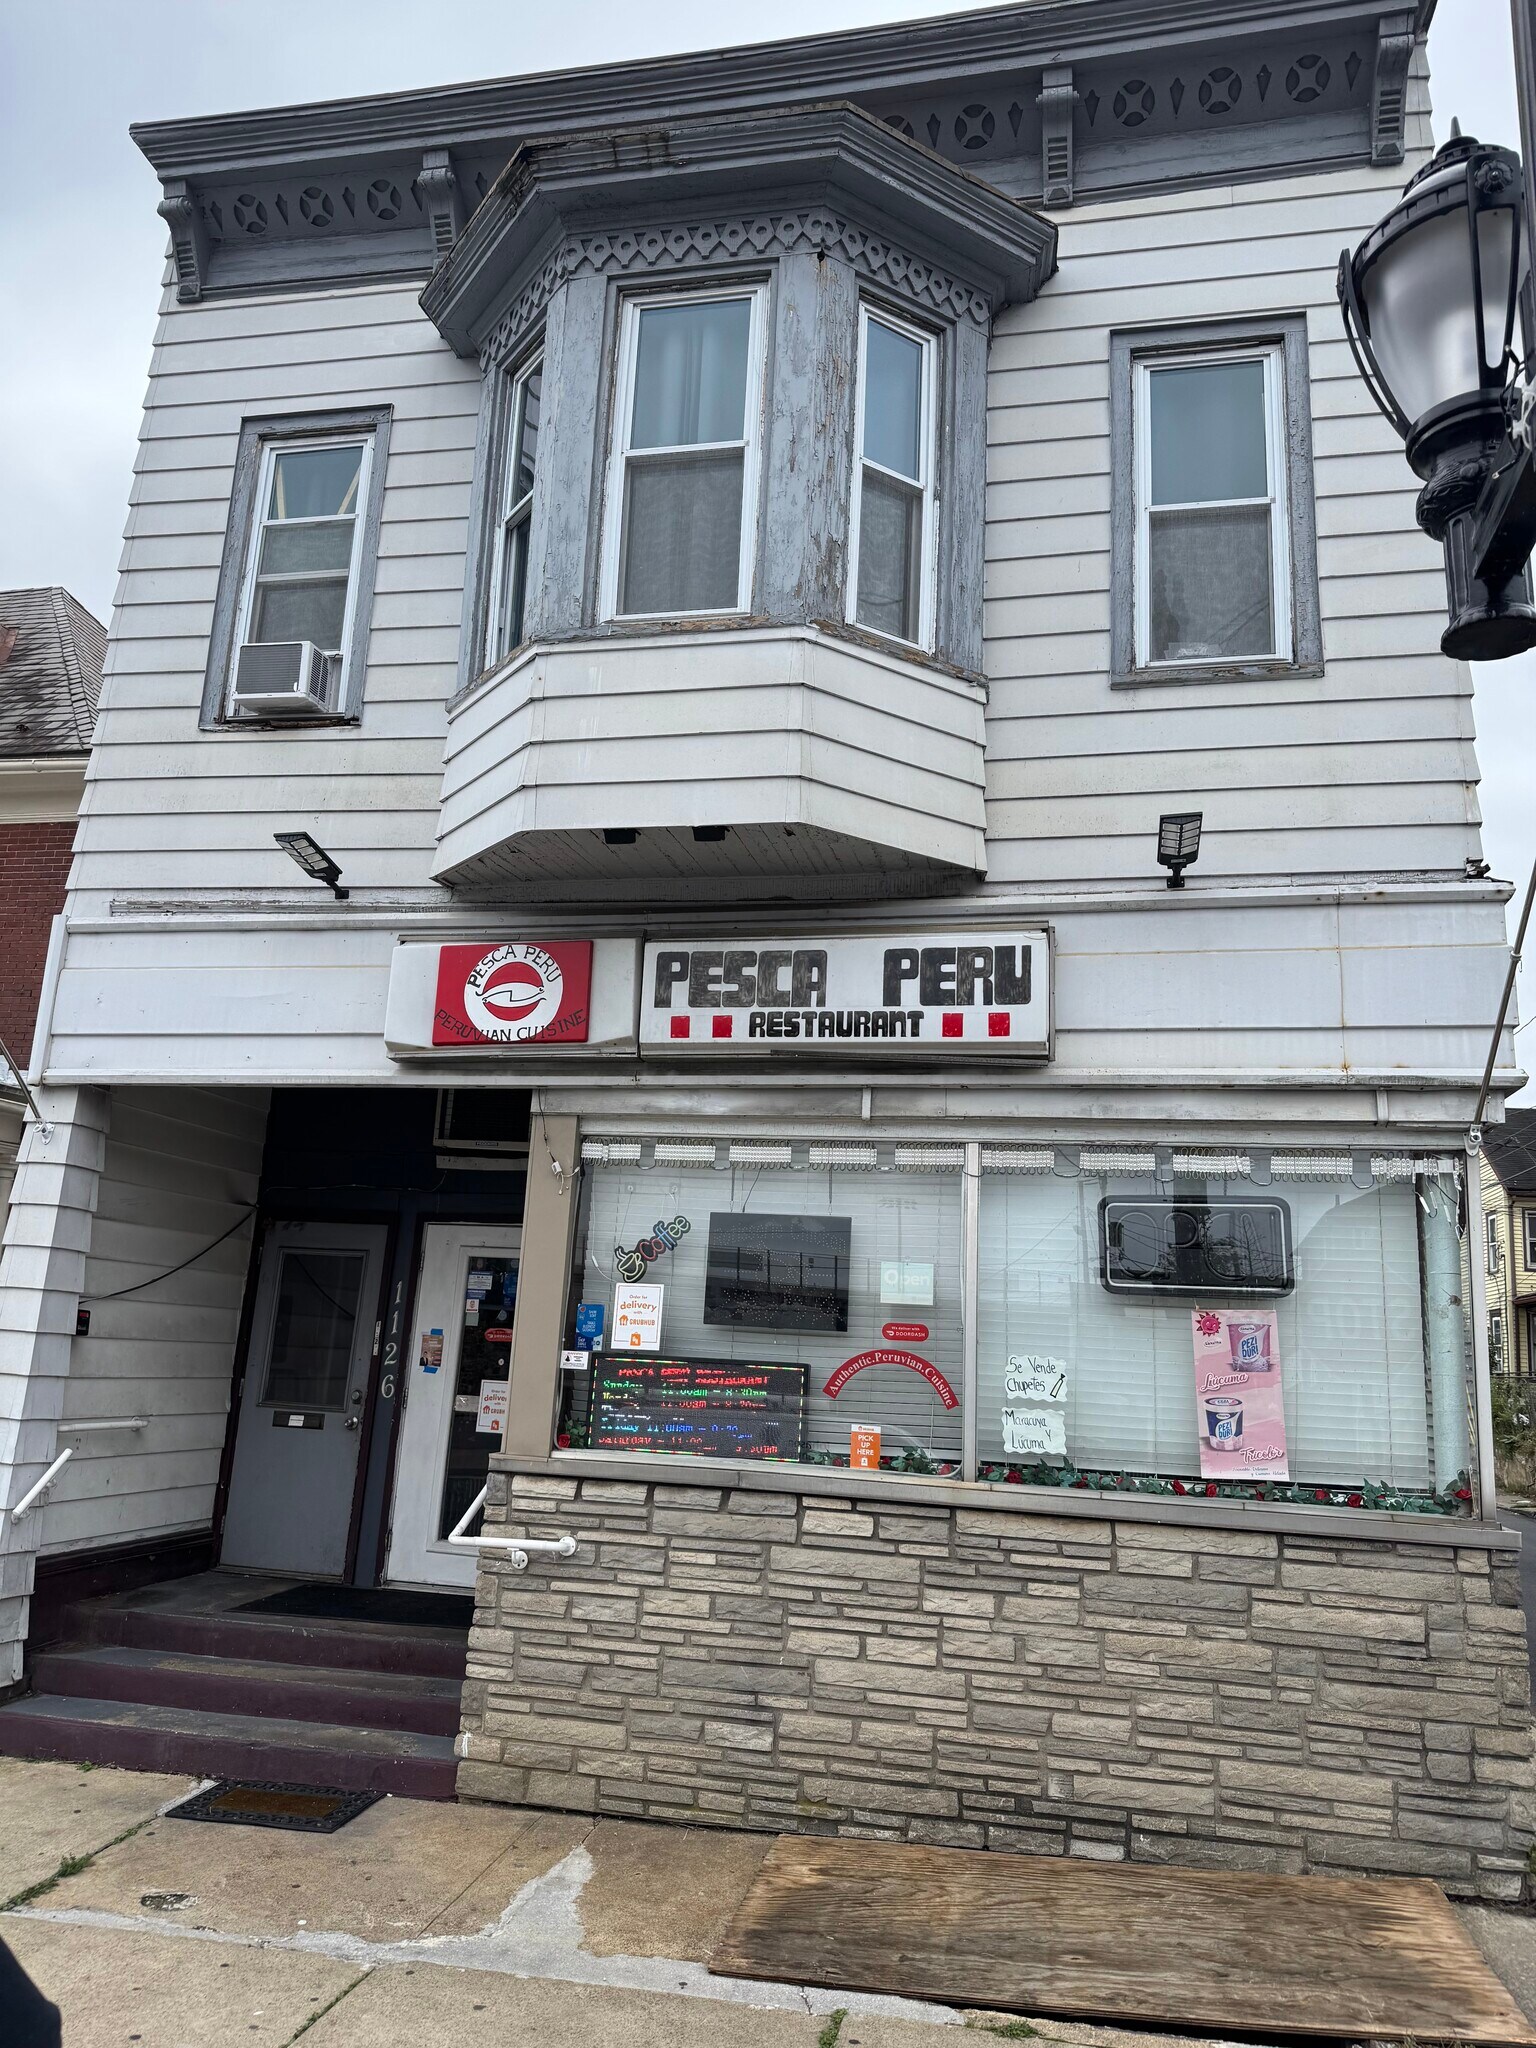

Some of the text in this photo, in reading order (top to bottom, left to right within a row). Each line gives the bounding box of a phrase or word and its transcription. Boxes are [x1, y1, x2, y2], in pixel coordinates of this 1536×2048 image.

[467, 944, 562, 988] PESCA PERU
[653, 944, 1032, 1009] PESCA PERU
[433, 1008, 586, 1041] PERUVIAN CUISINE
[749, 1010, 925, 1038] RESTAURANT
[638, 1215, 691, 1262] Coffee
[620, 1300, 657, 1313] delivery
[629, 1318, 656, 1326] GRUBHUB
[1006, 1356, 1057, 1374] Se Vende
[1006, 1376, 1046, 1395] Chupetes
[1004, 1409, 1048, 1428] Maracuya
[857, 1434, 875, 1442] PICK
[860, 1441, 871, 1449] UP
[1011, 1430, 1047, 1450] Lúcuma
[856, 1448, 875, 1456] HERE
